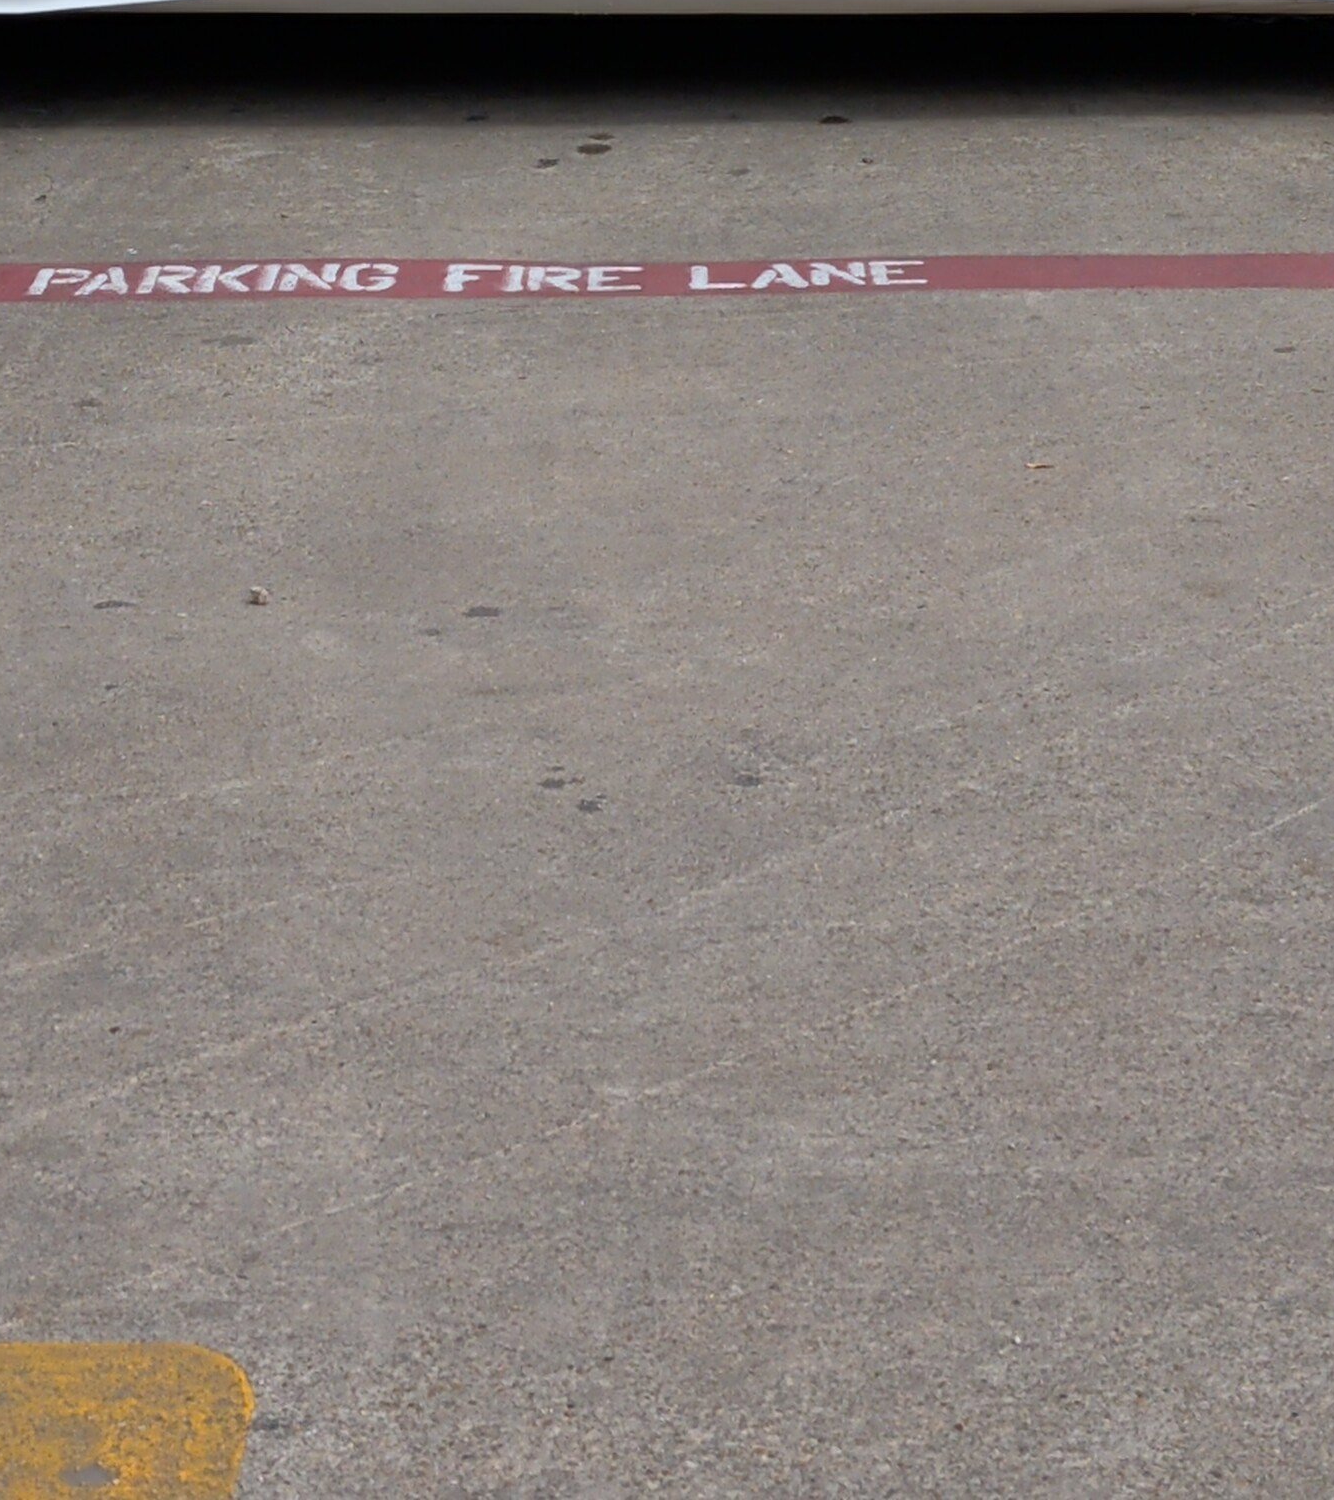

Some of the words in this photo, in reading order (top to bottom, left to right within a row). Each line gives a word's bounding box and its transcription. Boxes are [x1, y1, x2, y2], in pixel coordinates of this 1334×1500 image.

[25, 262, 400, 297] PARKING
[442, 262, 644, 293] FIRE
[688, 259, 928, 291] LANE
